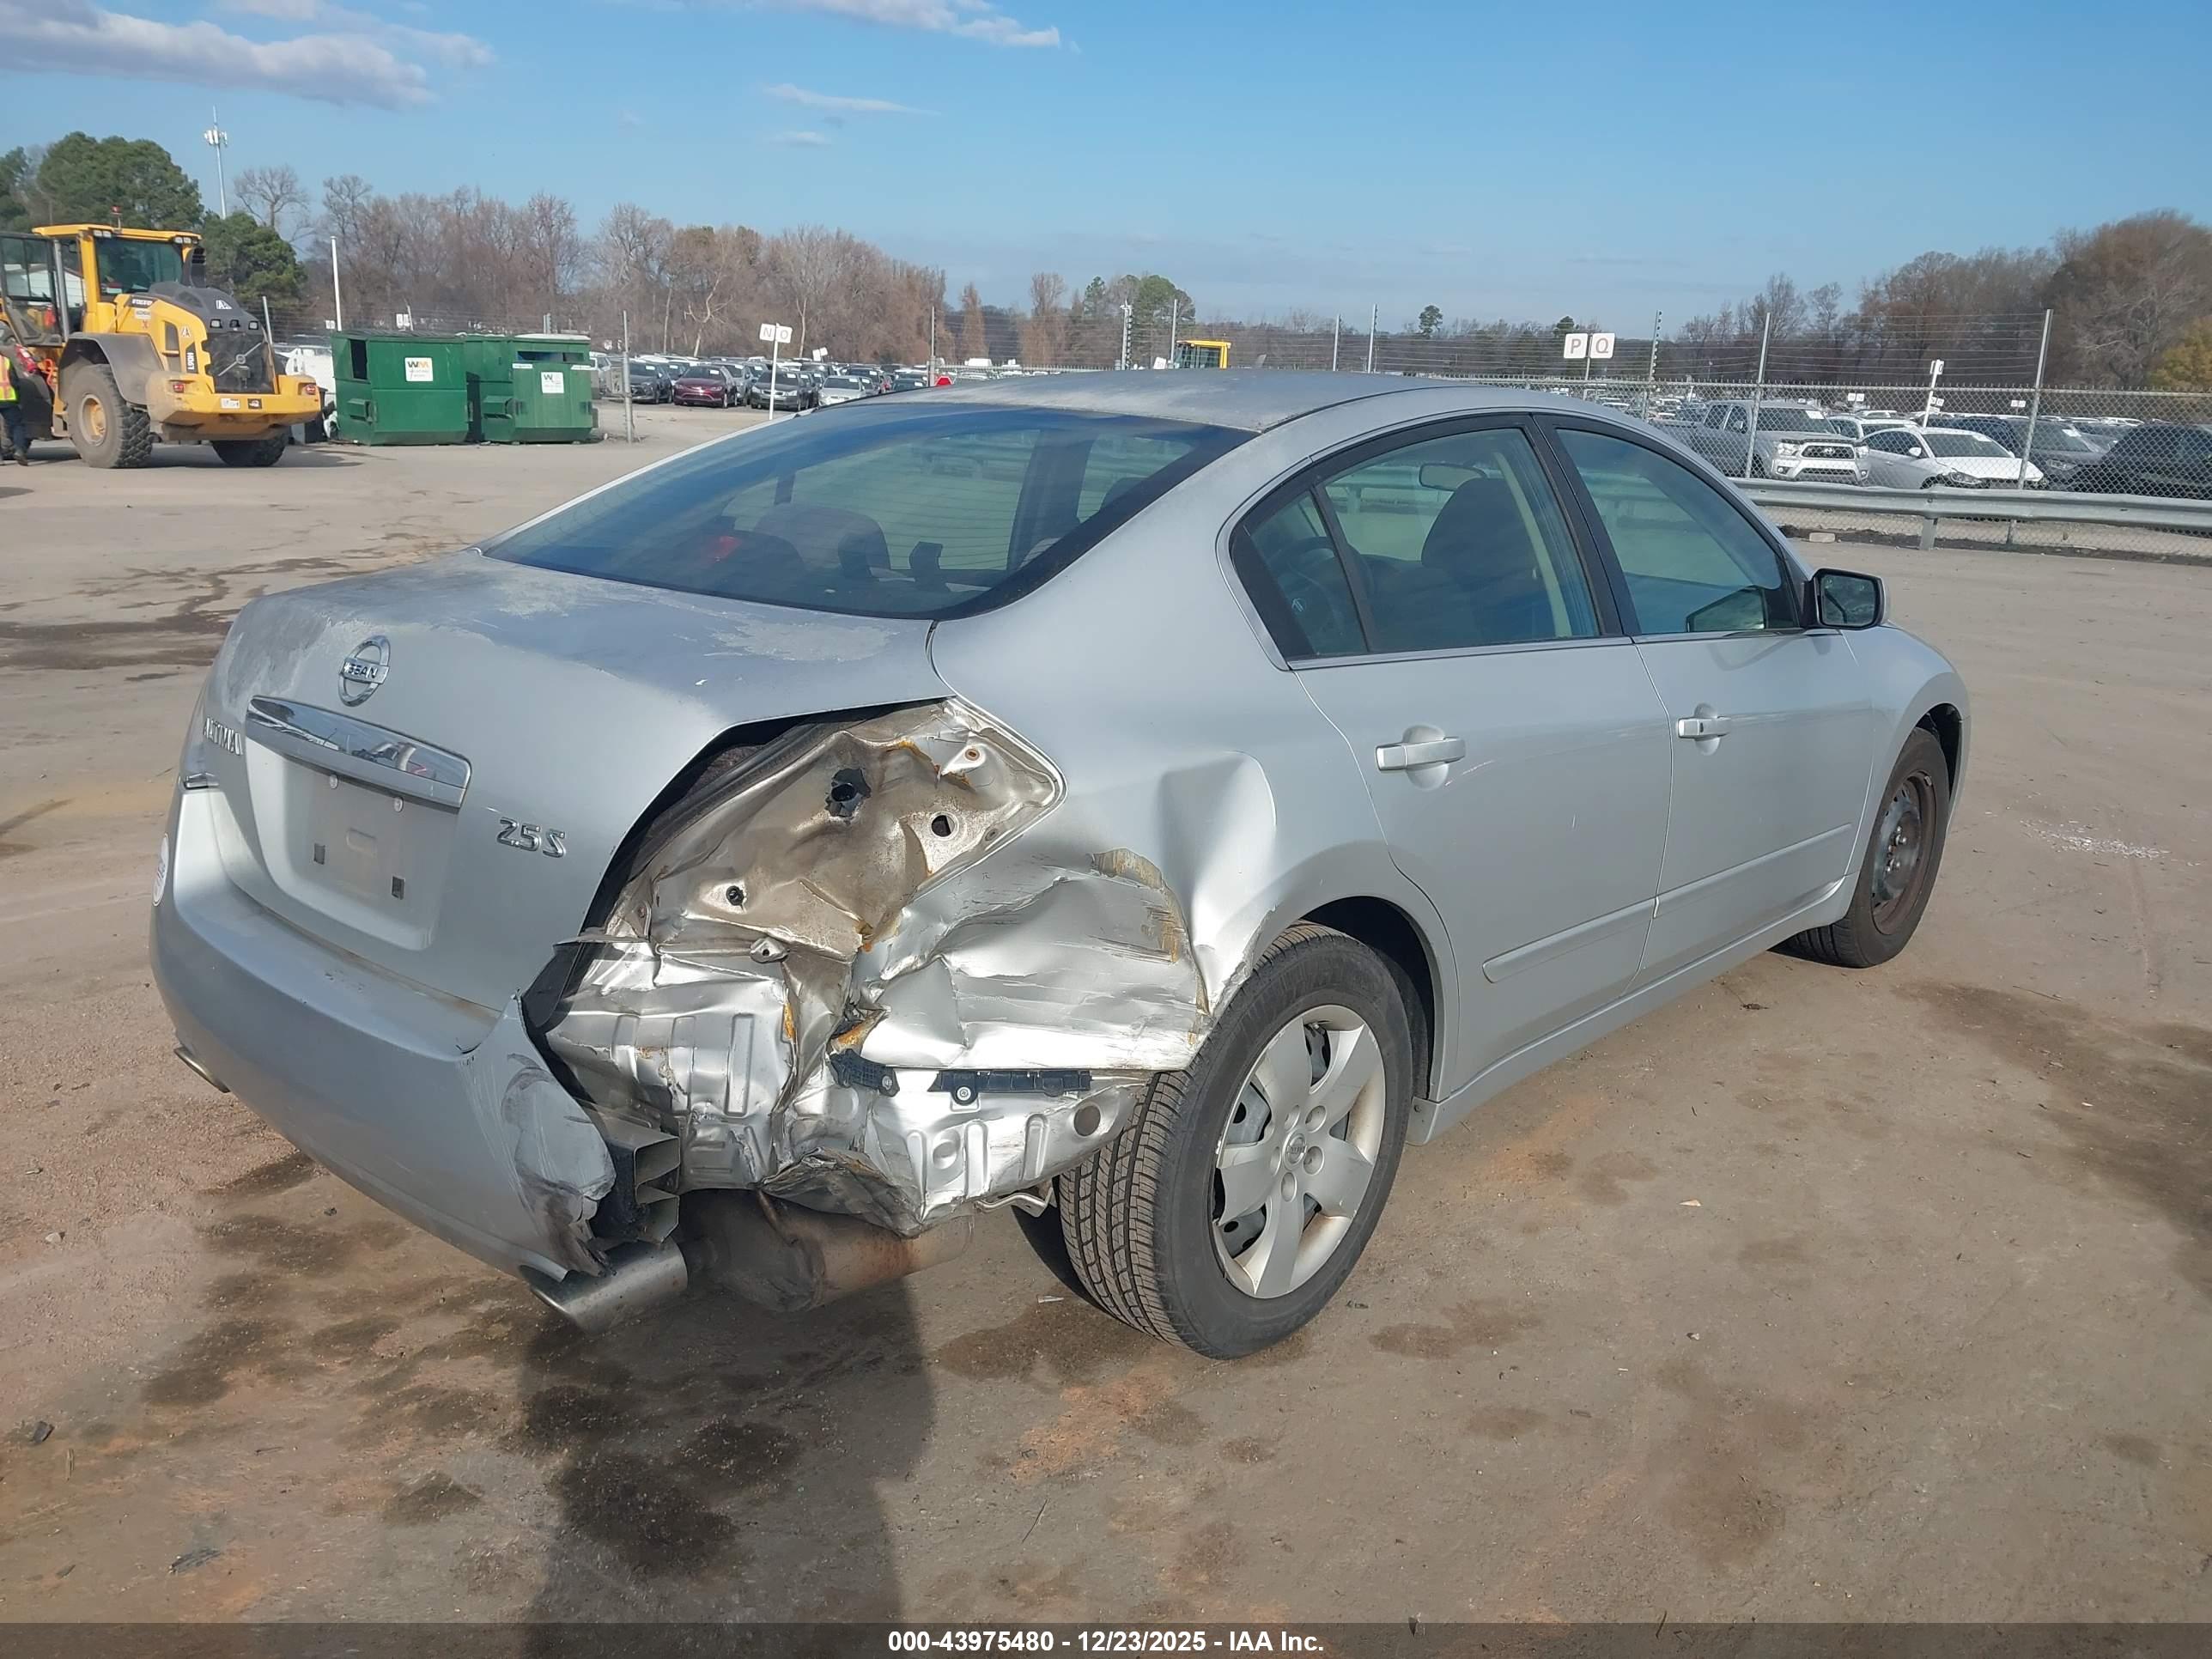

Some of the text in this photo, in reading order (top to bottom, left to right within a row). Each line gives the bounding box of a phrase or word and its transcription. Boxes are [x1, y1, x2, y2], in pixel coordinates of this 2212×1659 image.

[763, 327, 772, 337] N
[1570, 338, 1582, 354] P
[1595, 337, 1608, 353] Q
[542, 828, 566, 858] S
